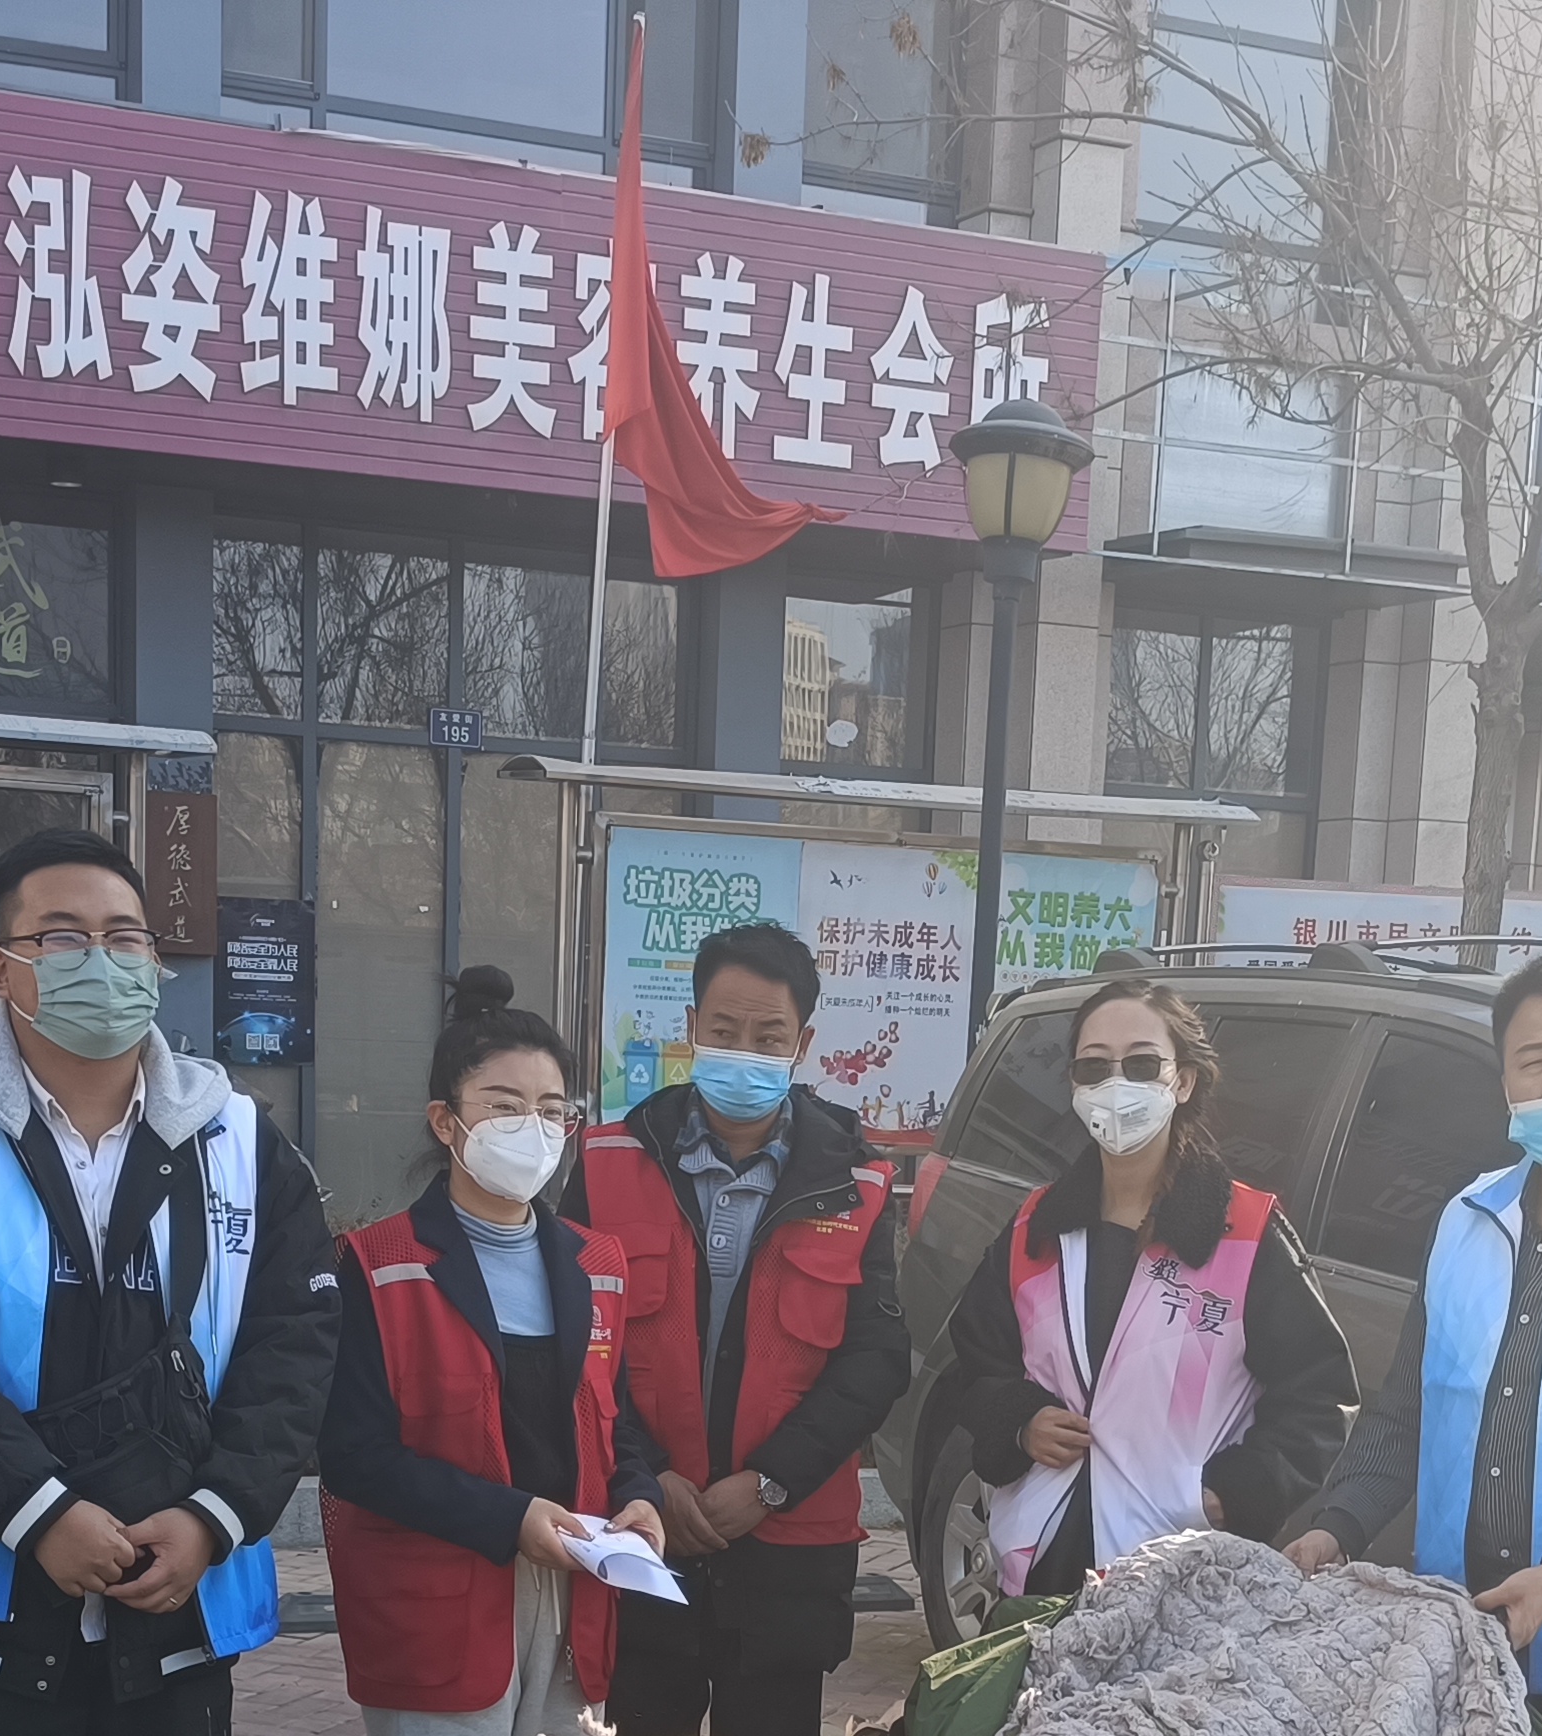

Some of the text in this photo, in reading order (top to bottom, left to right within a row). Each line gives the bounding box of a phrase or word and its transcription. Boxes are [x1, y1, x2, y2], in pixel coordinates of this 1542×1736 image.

[442, 725, 469, 743] 195
[625, 867, 760, 914] 垃圾分类
[1007, 888, 1133, 931] 文明养犬
[817, 916, 962, 951] 保护未成年人
[816, 949, 960, 983] 呵护健康成长
[1160, 1289, 1232, 1336] 宁夏
